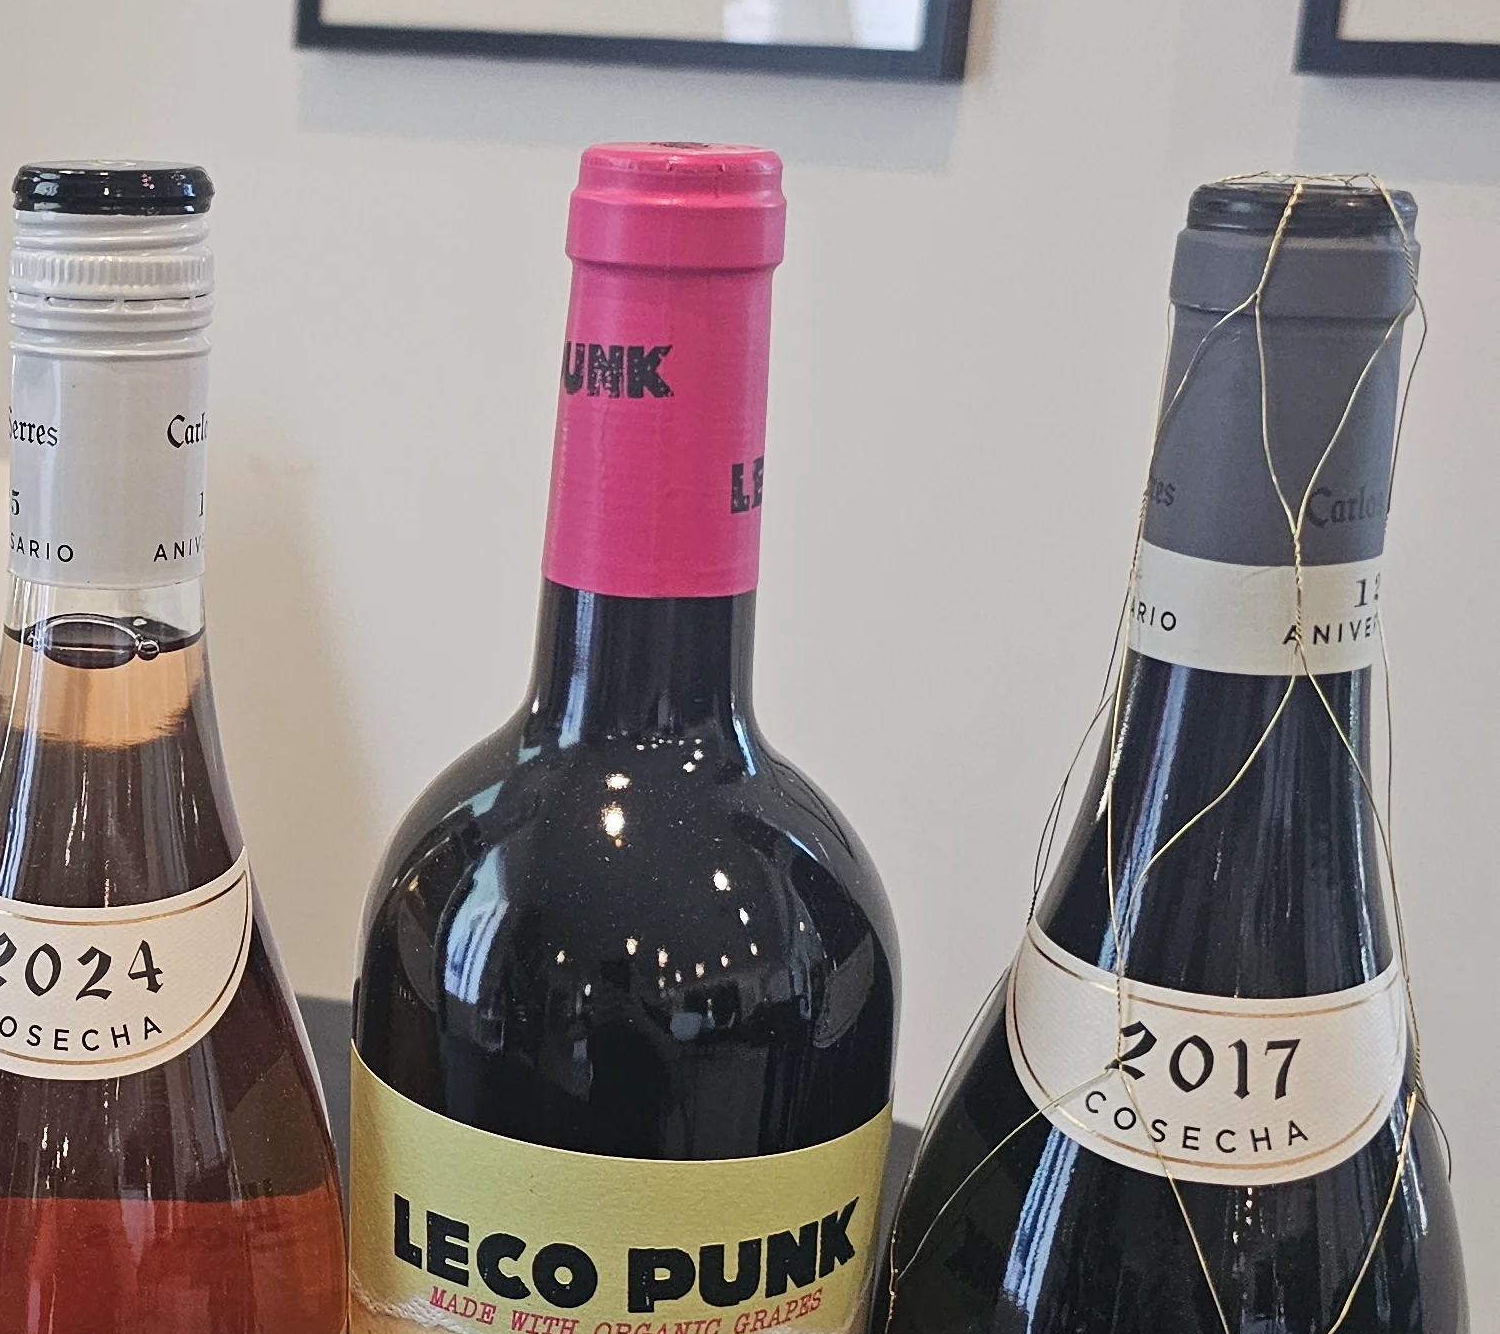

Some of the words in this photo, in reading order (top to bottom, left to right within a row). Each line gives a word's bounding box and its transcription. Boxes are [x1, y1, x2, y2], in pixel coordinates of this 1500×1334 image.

[1104, 1020, 1301, 1100] 2017
[1085, 1090, 1309, 1154] COSECHA
[393, 1193, 599, 1309] LECO
[626, 1195, 860, 1314] PUNK
[429, 1285, 496, 1327] MADE
[733, 1287, 825, 1334] GRAPES
